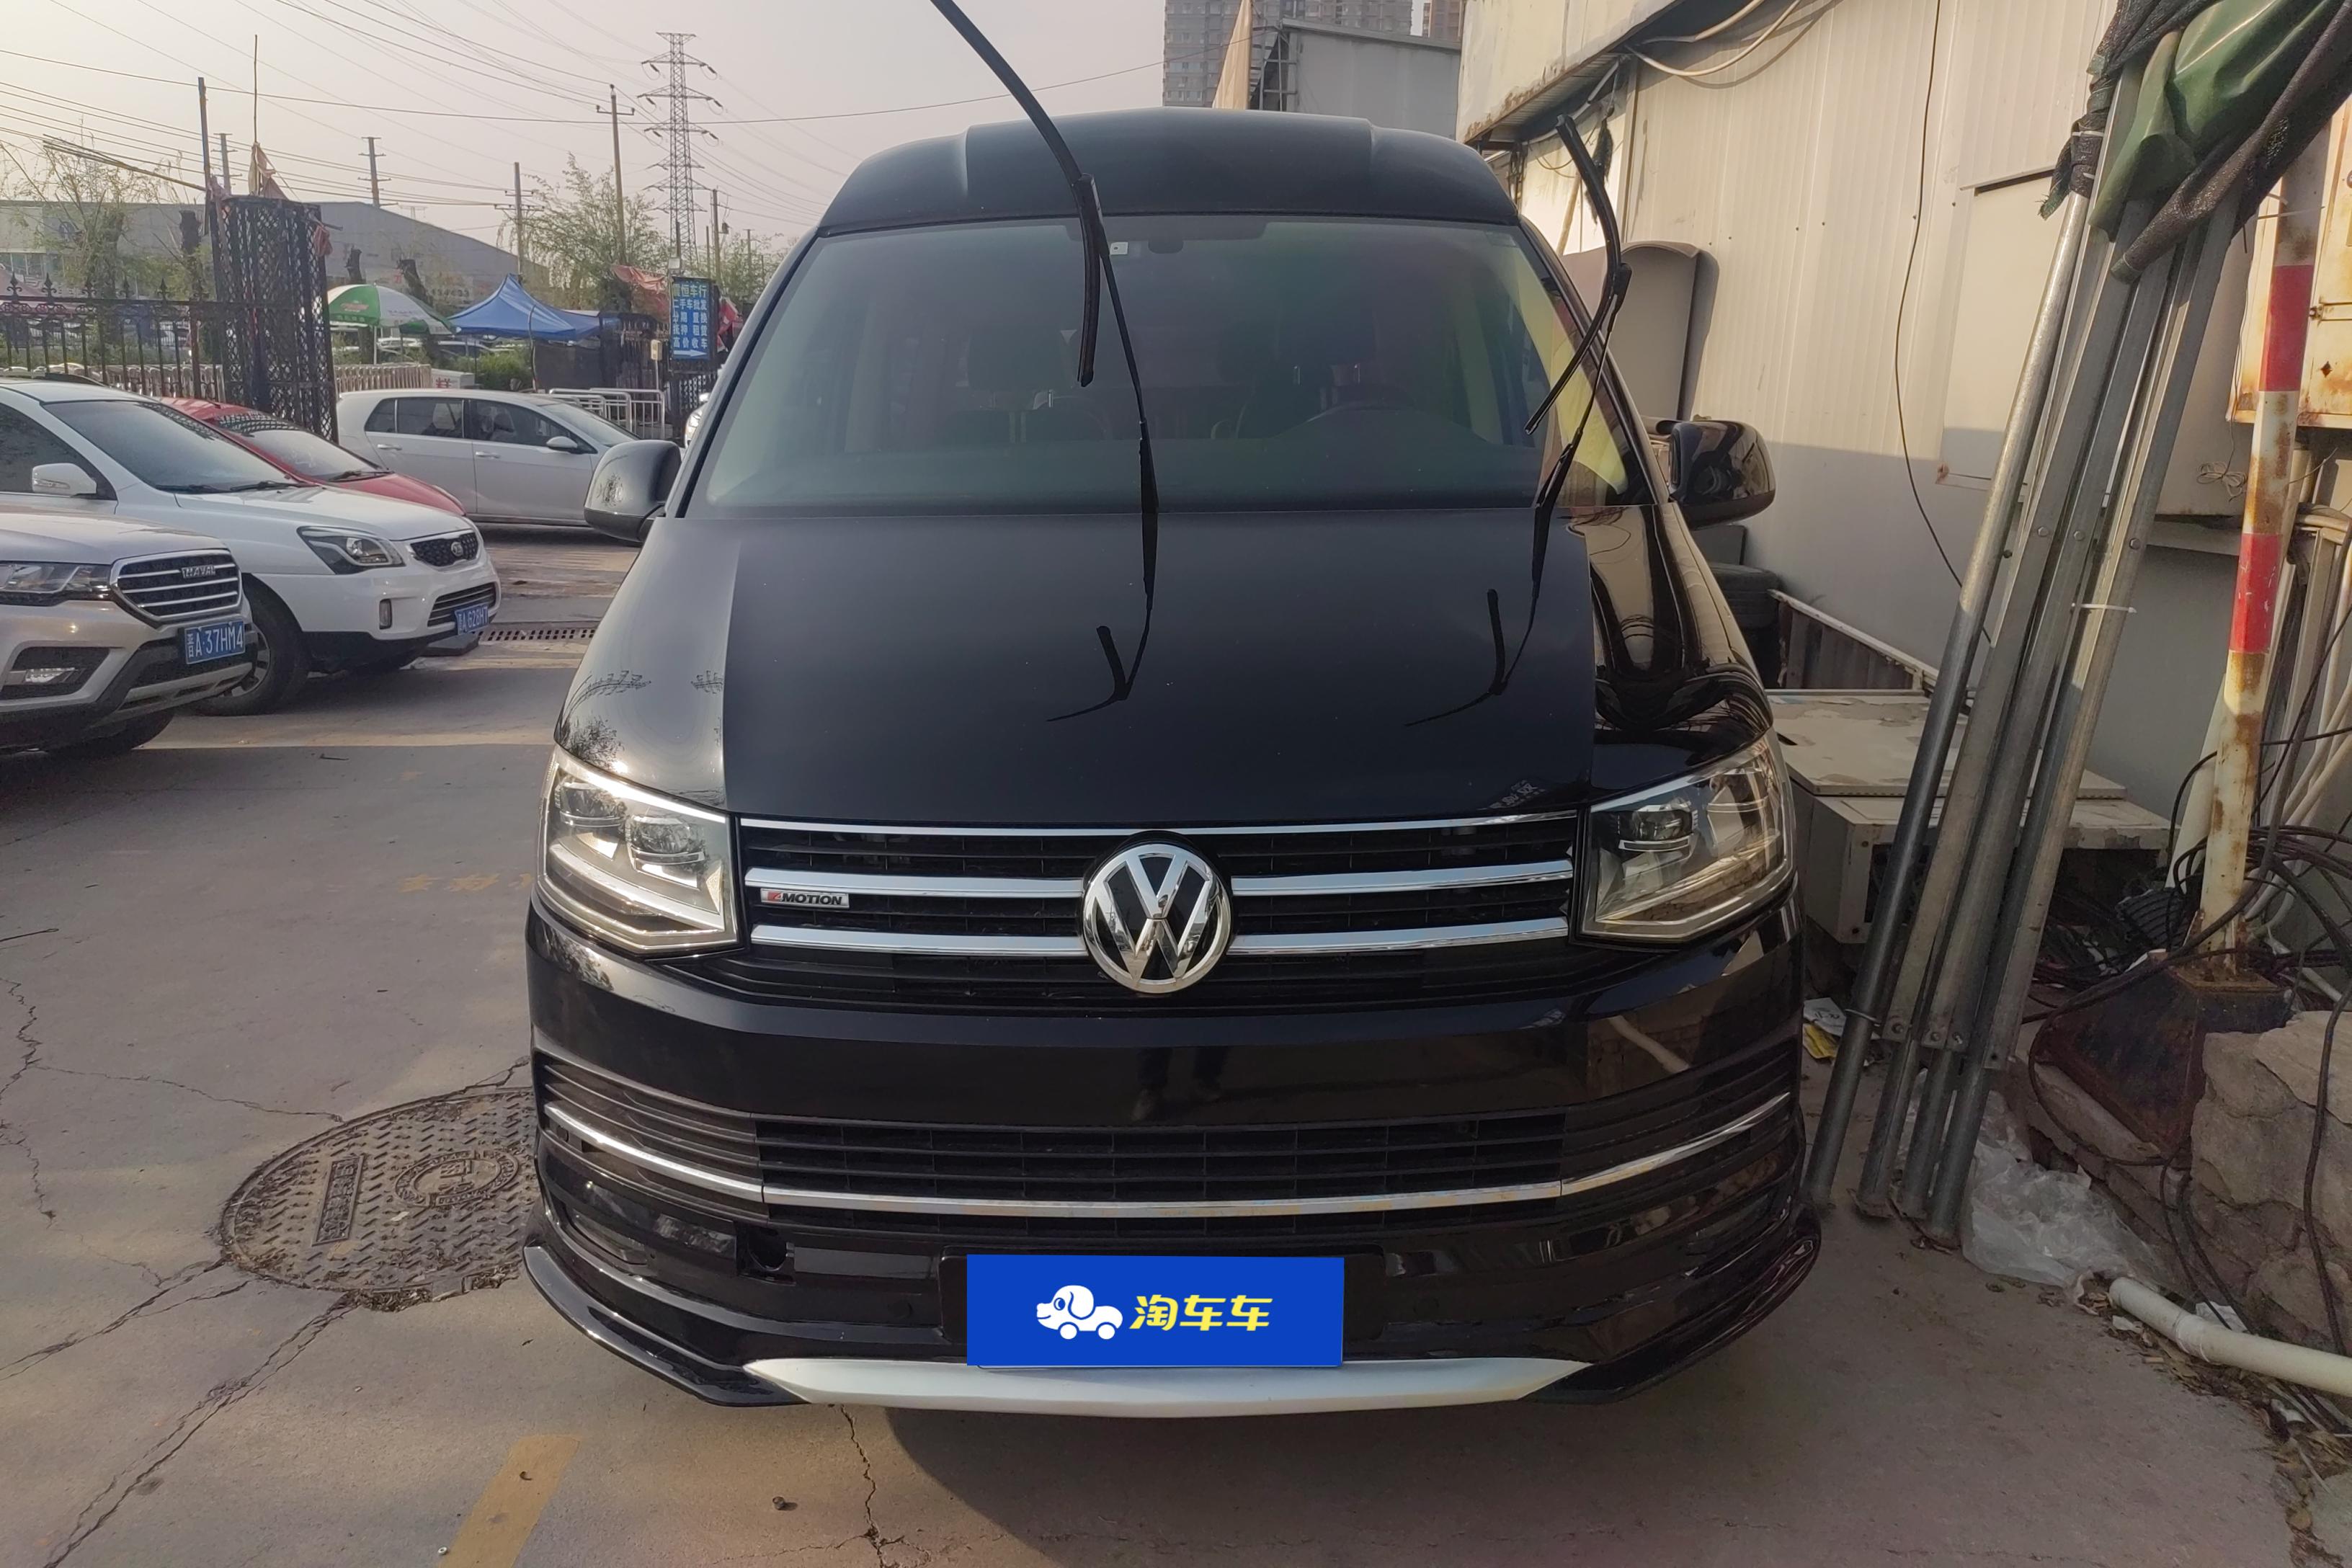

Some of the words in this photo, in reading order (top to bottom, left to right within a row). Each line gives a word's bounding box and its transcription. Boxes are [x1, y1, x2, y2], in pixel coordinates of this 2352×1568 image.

[673, 298, 707, 310] 二手车批发
[672, 336, 708, 349] 高价收车
[186, 566, 216, 577] HAVAL
[767, 891, 842, 905] 4MOTION
